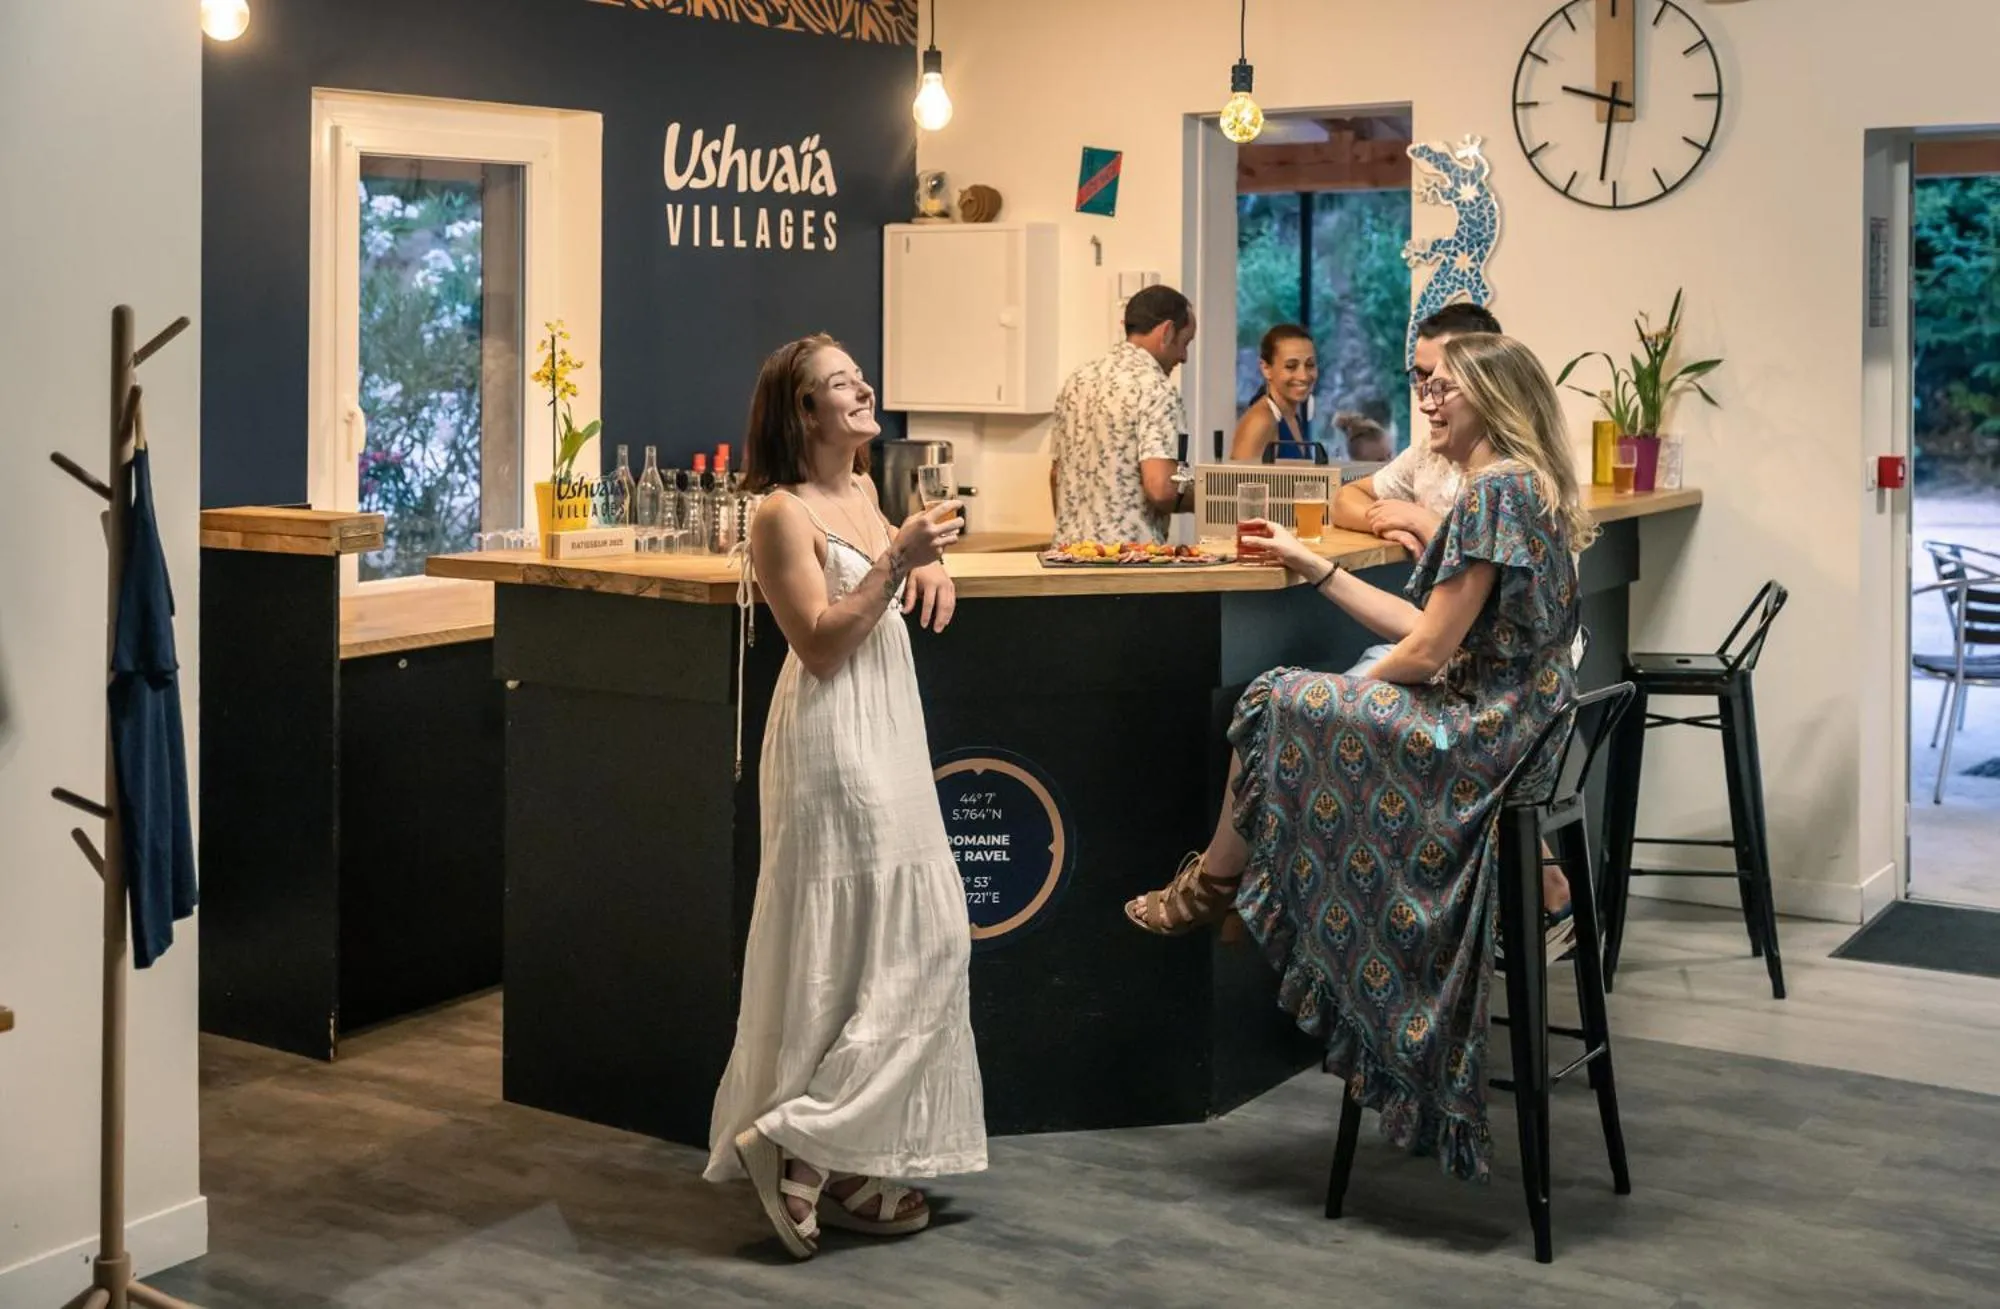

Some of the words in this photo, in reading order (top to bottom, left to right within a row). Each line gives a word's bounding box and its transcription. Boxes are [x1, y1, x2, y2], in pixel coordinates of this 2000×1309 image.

[663, 122, 838, 197] Ushuaïa
[666, 203, 838, 251] VILLAGES
[557, 503, 625, 519] VILLAGES
[964, 850, 1011, 862] RAVEL
